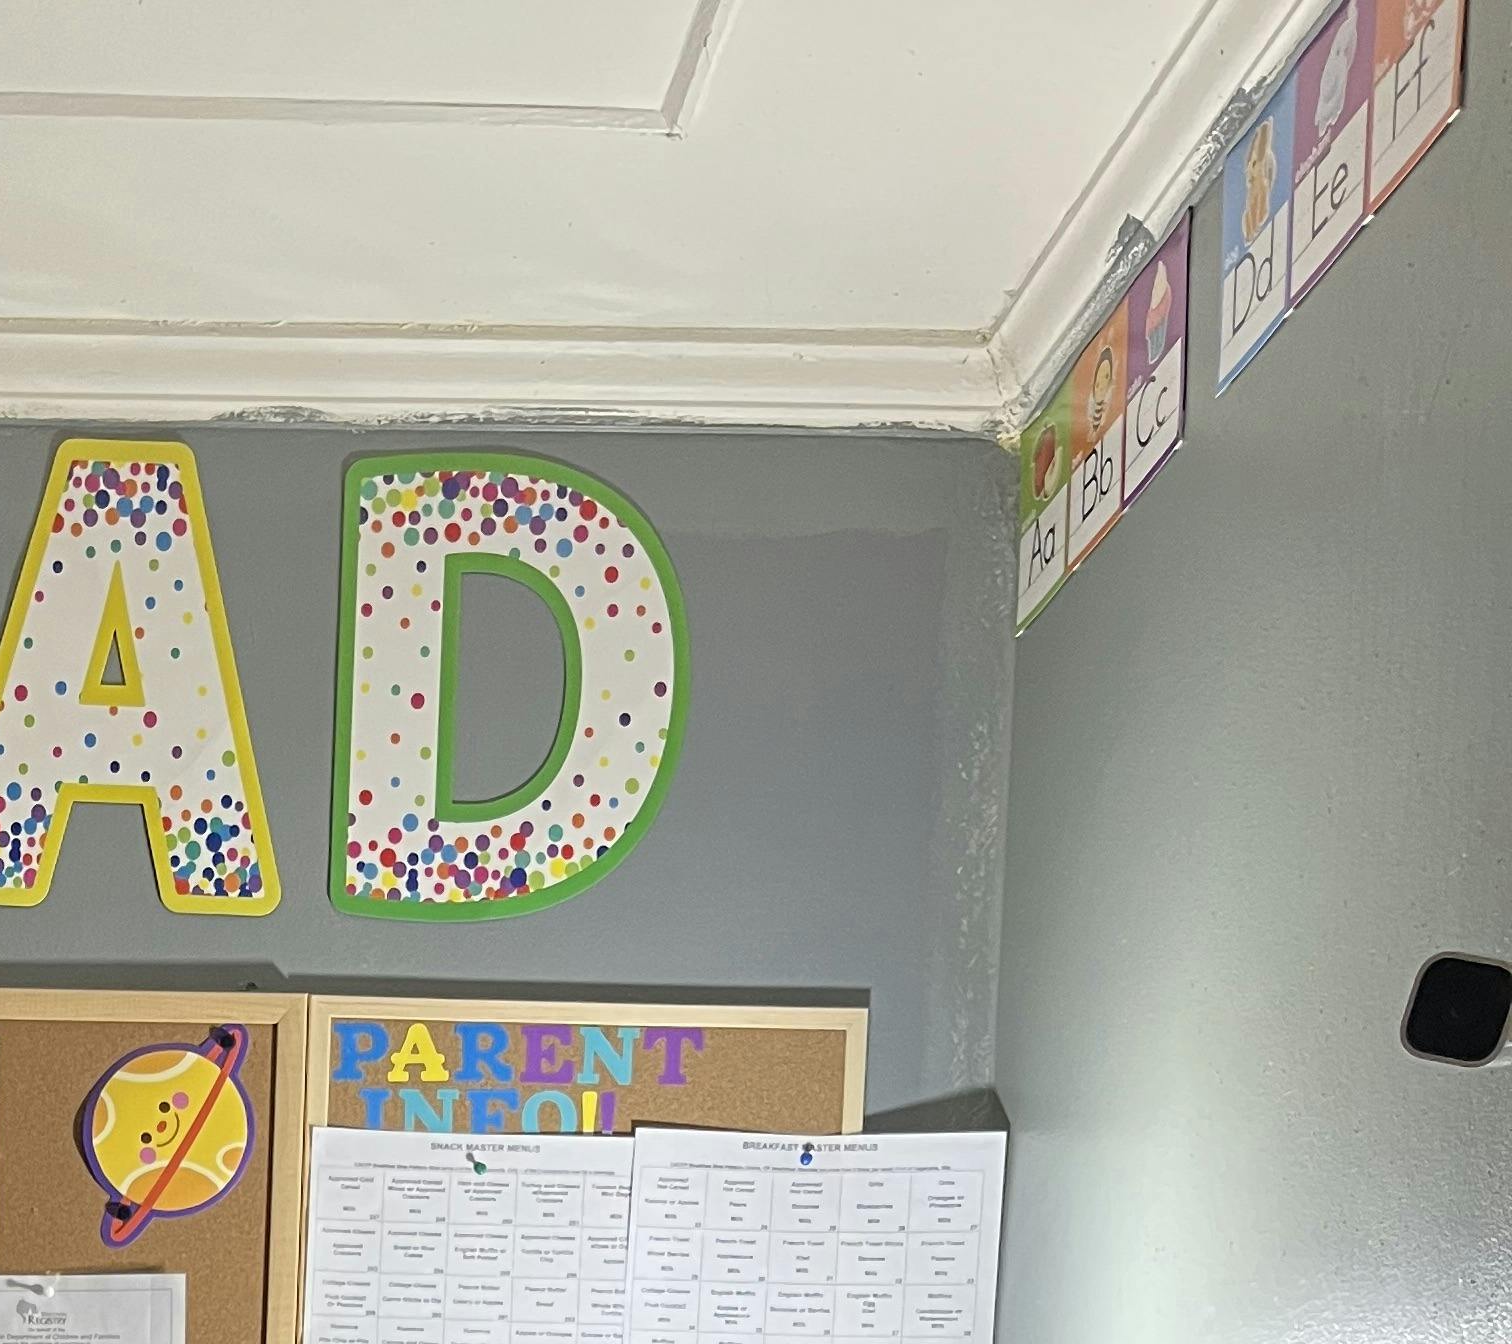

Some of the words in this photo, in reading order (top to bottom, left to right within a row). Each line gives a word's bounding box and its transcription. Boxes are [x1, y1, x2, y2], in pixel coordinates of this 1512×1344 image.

[1310, 158, 1349, 240] Ee
[1231, 224, 1274, 336] Dd
[1136, 376, 1168, 448] Cc
[1080, 439, 1114, 522] Bb
[1028, 518, 1056, 588] Aa
[333, 1022, 703, 1085] PARENT
[430, 1143, 463, 1152] SNACK
[466, 1144, 504, 1153] MASTER
[507, 1145, 540, 1153] MENUS
[743, 1141, 798, 1151] BREAKFAST
[844, 1144, 878, 1152] MENUS
